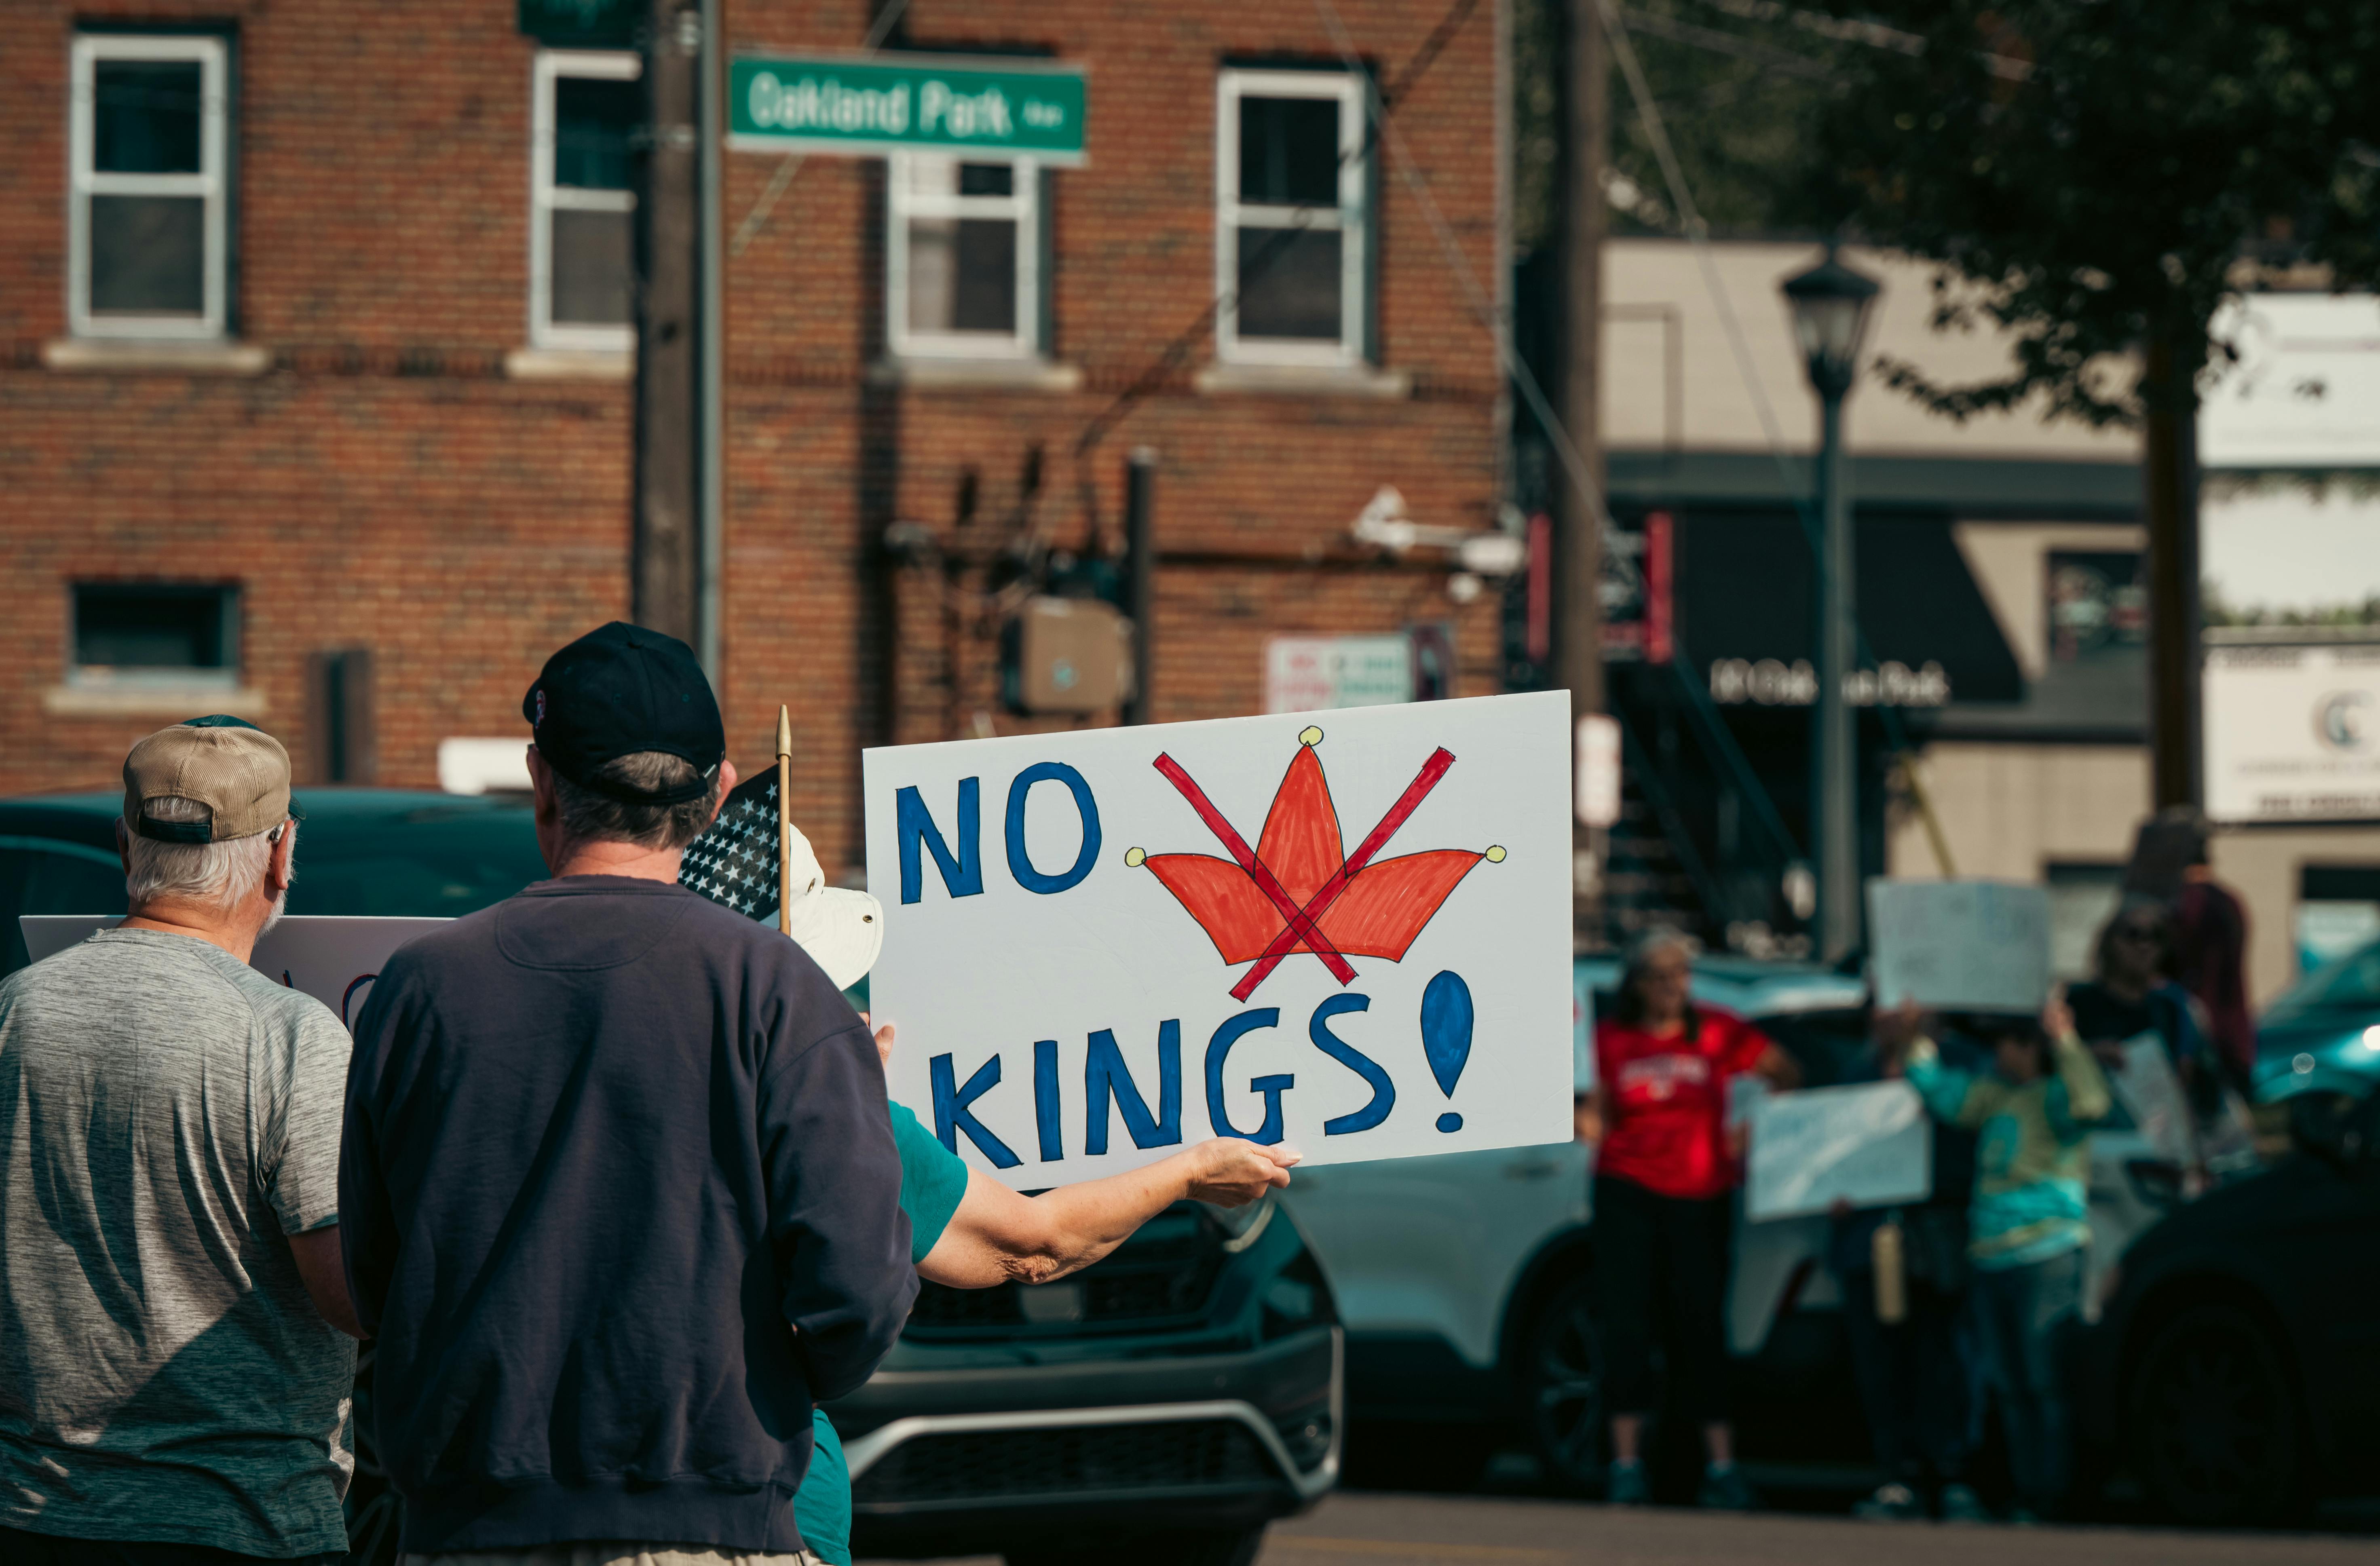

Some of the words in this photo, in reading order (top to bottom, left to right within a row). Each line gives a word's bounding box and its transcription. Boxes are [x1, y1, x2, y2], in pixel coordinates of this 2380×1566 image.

[749, 72, 910, 135] Oakland
[920, 81, 1013, 137] Park
[896, 762, 1102, 905] NO
[929, 970, 1474, 1169] KINGS!
